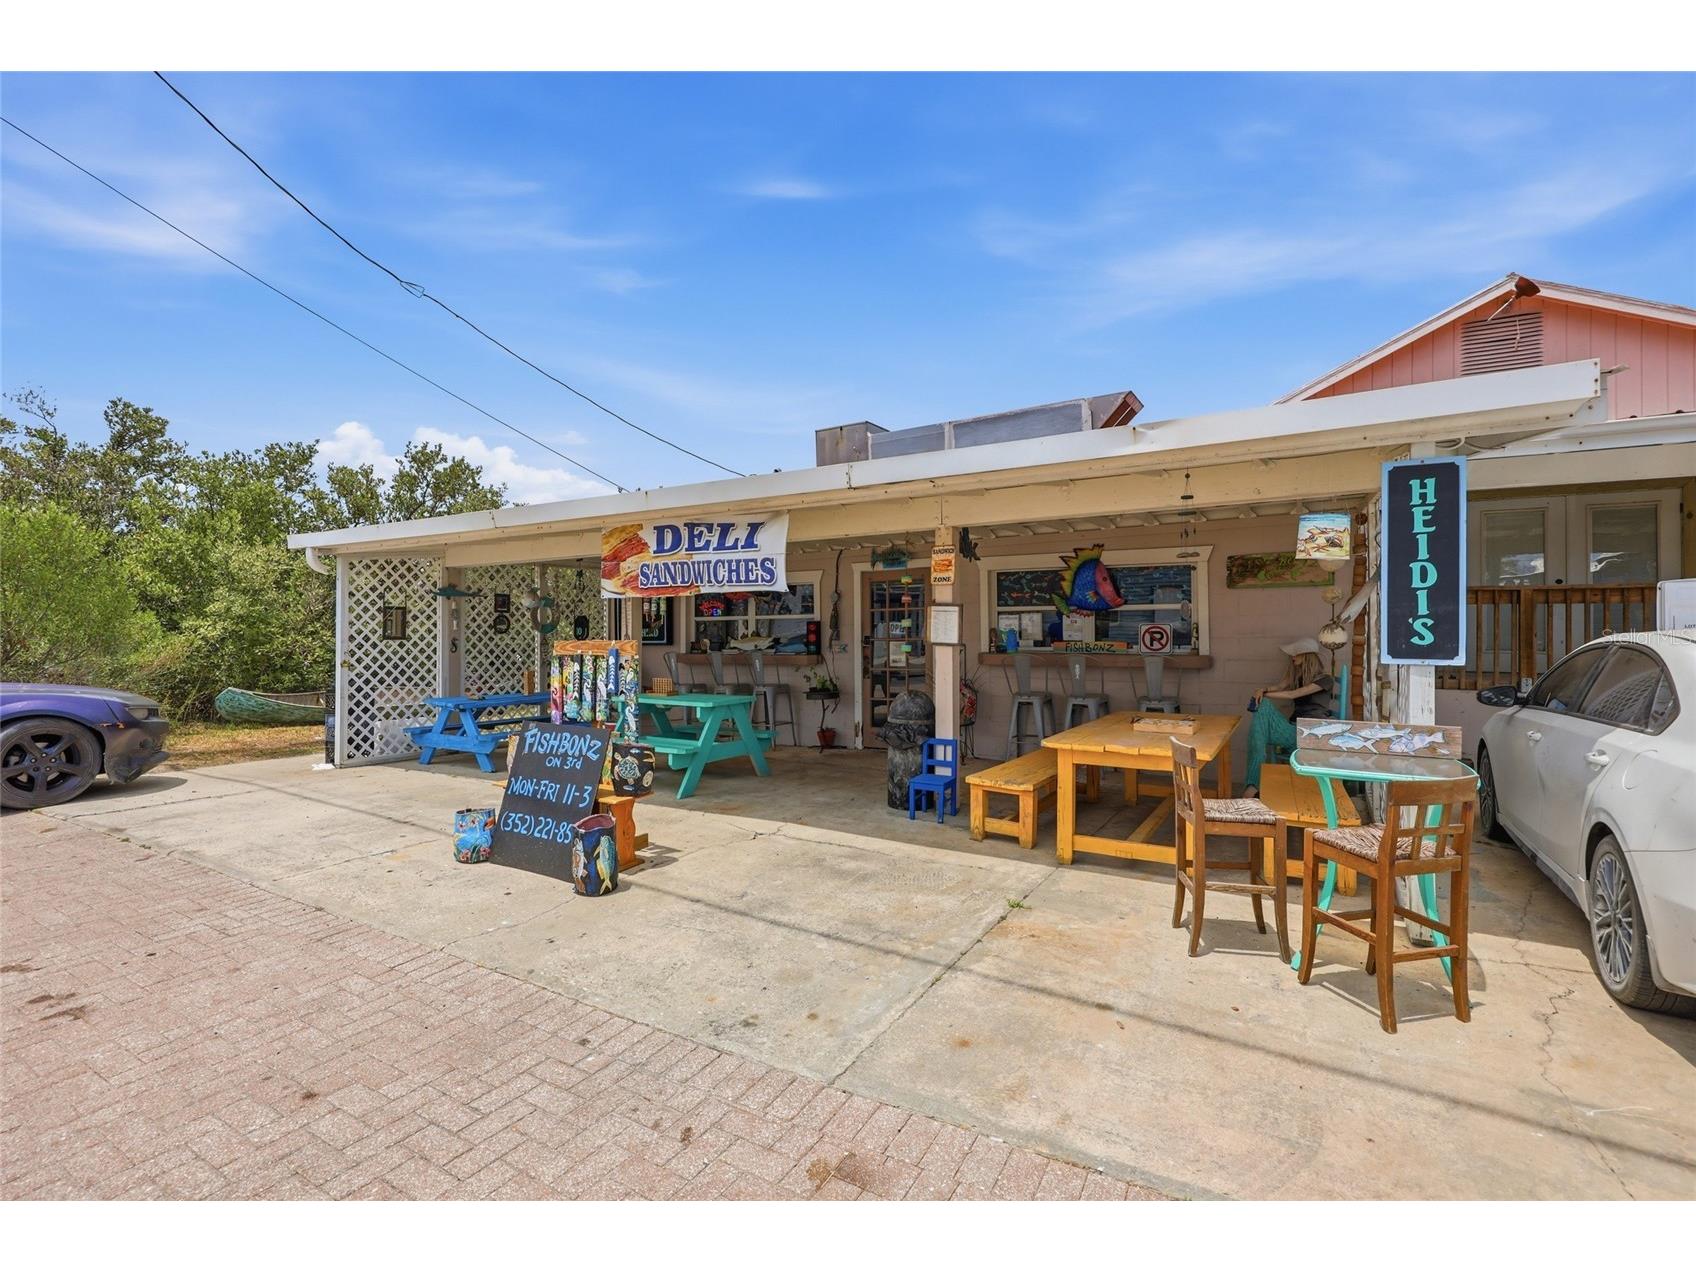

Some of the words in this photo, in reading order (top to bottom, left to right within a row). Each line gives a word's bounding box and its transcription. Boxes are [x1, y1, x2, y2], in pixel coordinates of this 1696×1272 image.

[652, 521, 767, 555] DELI
[639, 557, 777, 587] SANDWICHES
[1408, 477, 1437, 646] HEIDI'S
[1065, 642, 1116, 653] FISHBONZ
[524, 727, 602, 761] FISHBONZ
[545, 756, 561, 768] ON
[563, 756, 583, 770] 3rd
[507, 776, 560, 803] MON-FRI
[562, 783, 592, 808] 11-3
[500, 810, 573, 844] (352)221-85
